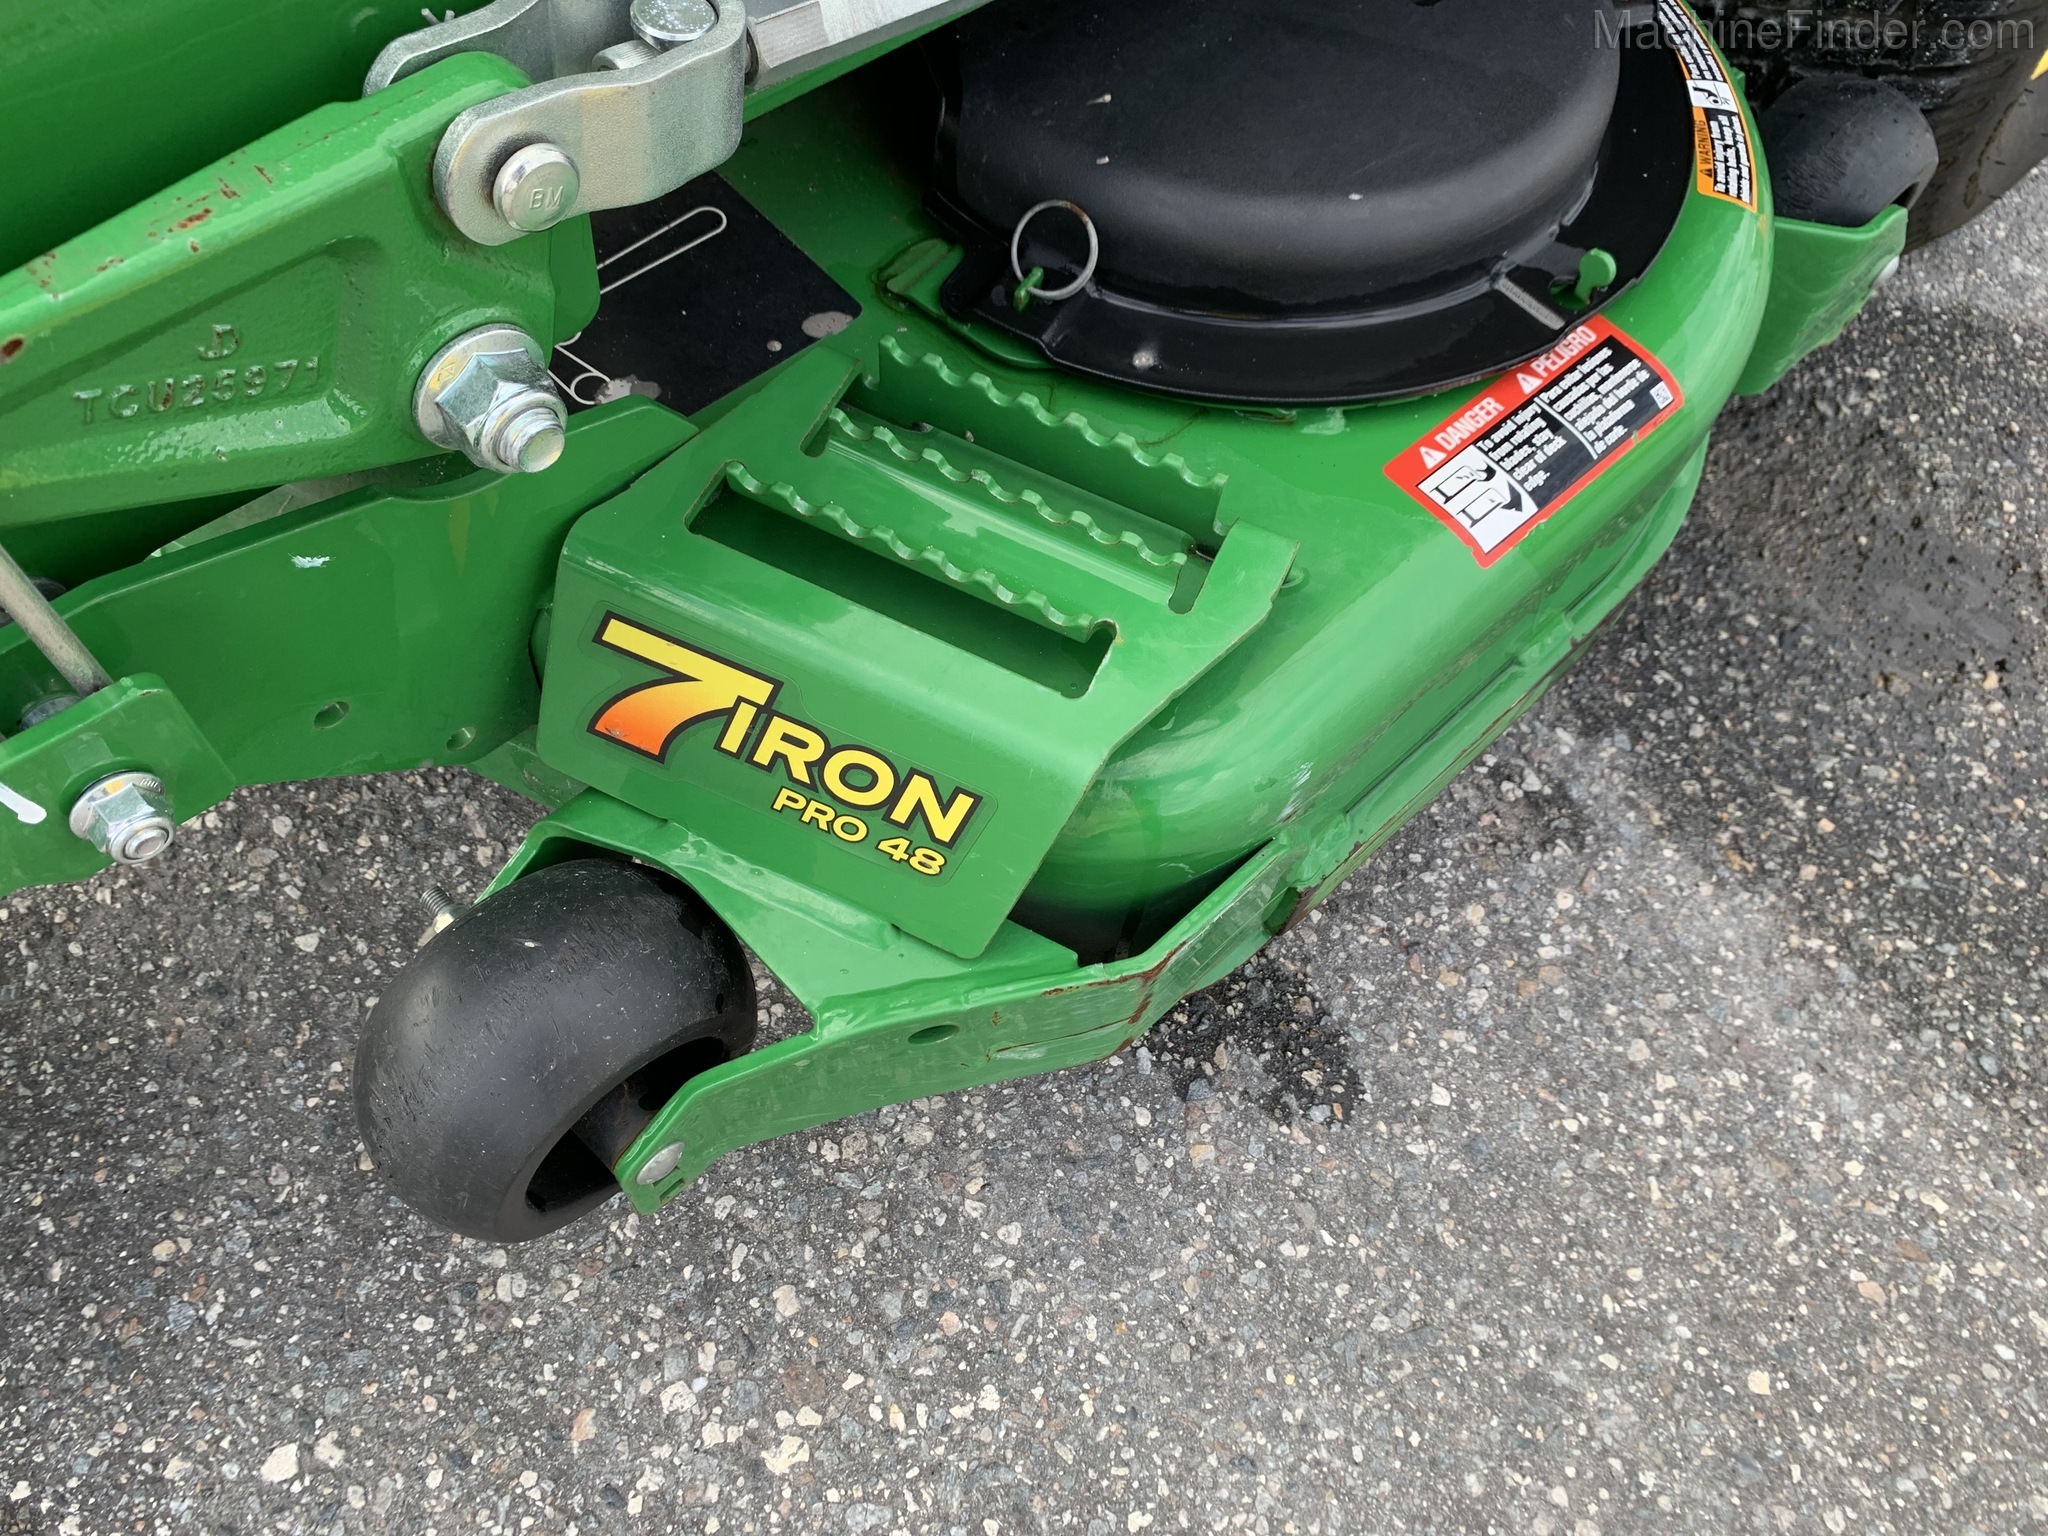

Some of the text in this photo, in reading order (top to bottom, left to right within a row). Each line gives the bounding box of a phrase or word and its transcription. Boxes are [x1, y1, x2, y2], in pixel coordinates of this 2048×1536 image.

[529, 185, 564, 210] BM
[1530, 326, 1597, 378] PELIGRO
[72, 356, 319, 426] TCU25971
[1539, 385, 1563, 404] Para
[1434, 396, 1505, 452] DANGER
[1476, 402, 1541, 452] To avoid injury
[1488, 416, 1547, 461] from rotating
[1532, 428, 1555, 447] stay
[1512, 435, 1567, 481] clear of deck
[1594, 440, 1607, 454] de
[1523, 470, 1550, 492] edge.
[771, 787, 946, 876] PRO 48
